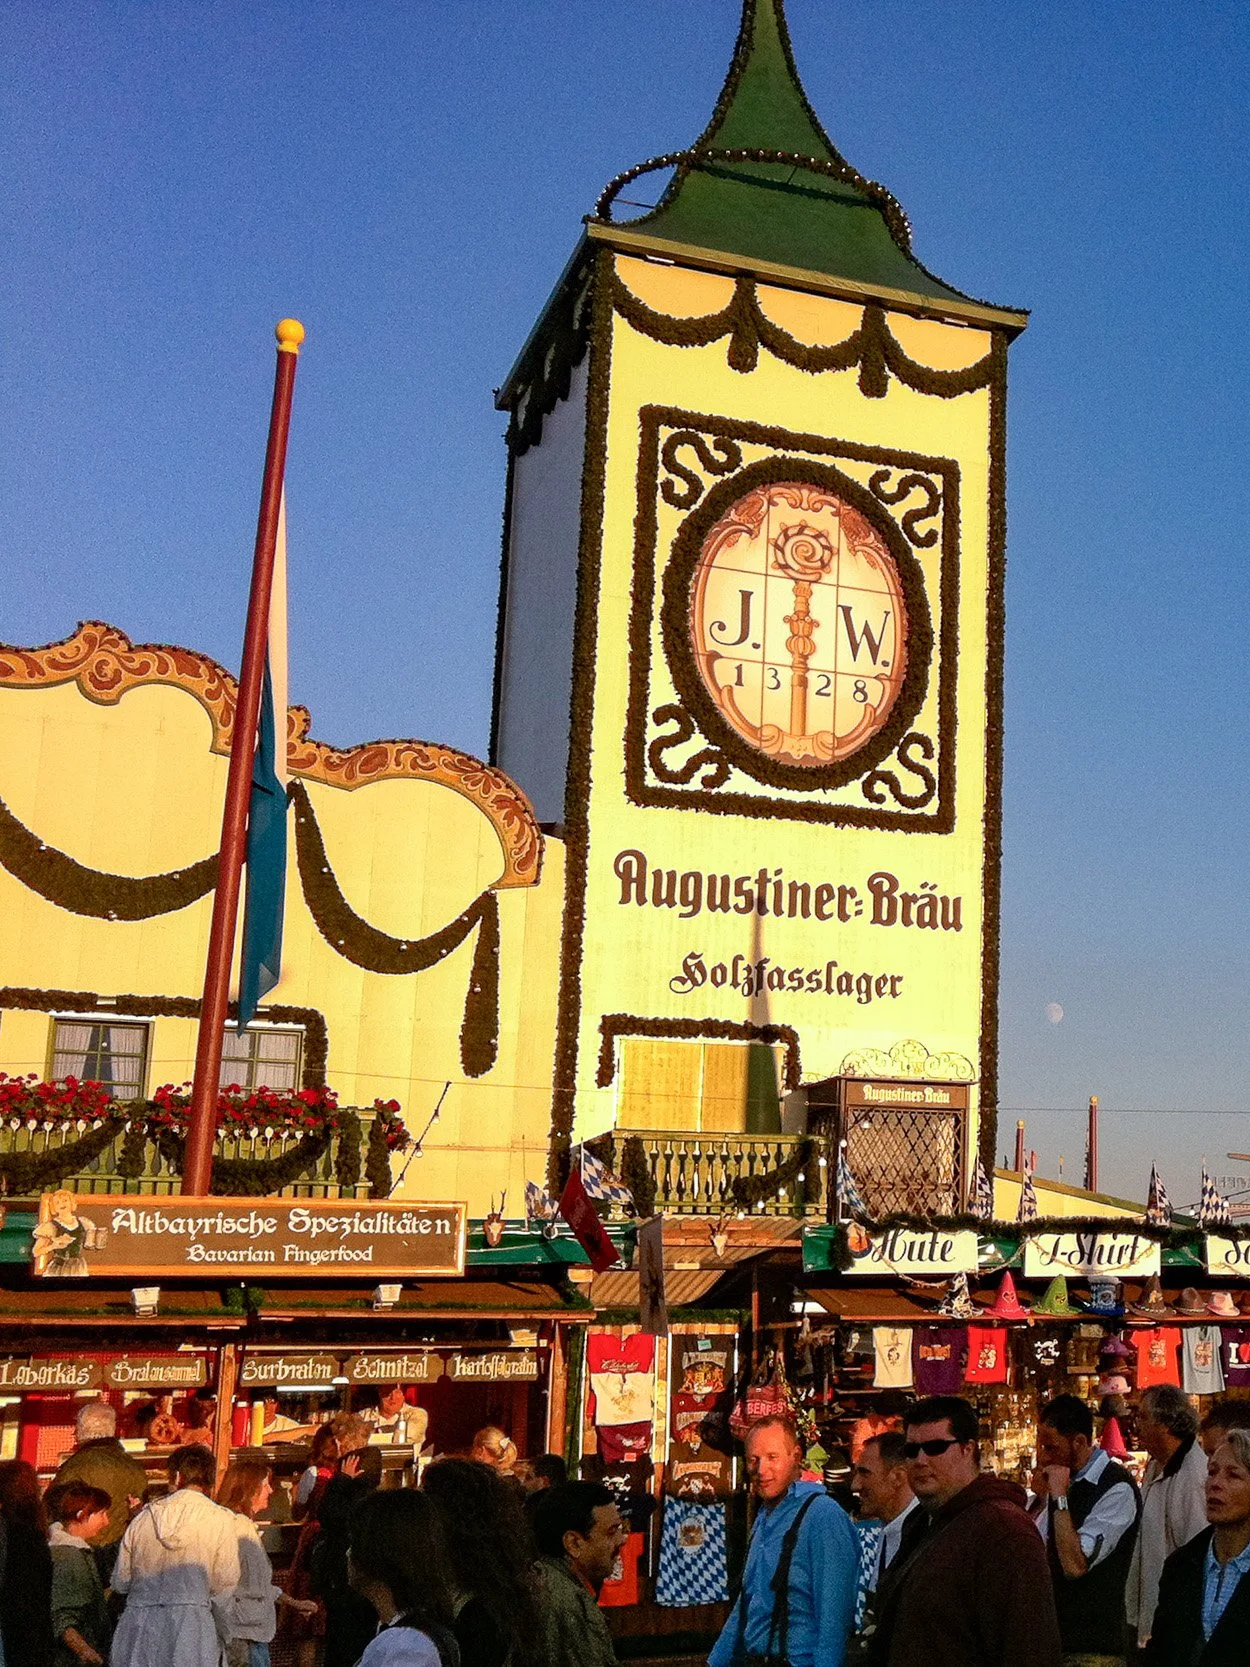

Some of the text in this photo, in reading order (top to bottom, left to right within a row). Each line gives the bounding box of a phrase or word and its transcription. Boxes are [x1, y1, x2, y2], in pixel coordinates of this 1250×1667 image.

[709, 589, 891, 668] J. W.
[669, 951, 904, 1005] Holzfasslager
[111, 1206, 452, 1240] Altbayrische Spezialitäten
[185, 1243, 374, 1266] Bavarian Fingerfood
[1038, 1231, 1139, 1267] T-Shirt
[242, 1357, 332, 1381] Surbraten
[353, 1355, 429, 1380] Schnitzel
